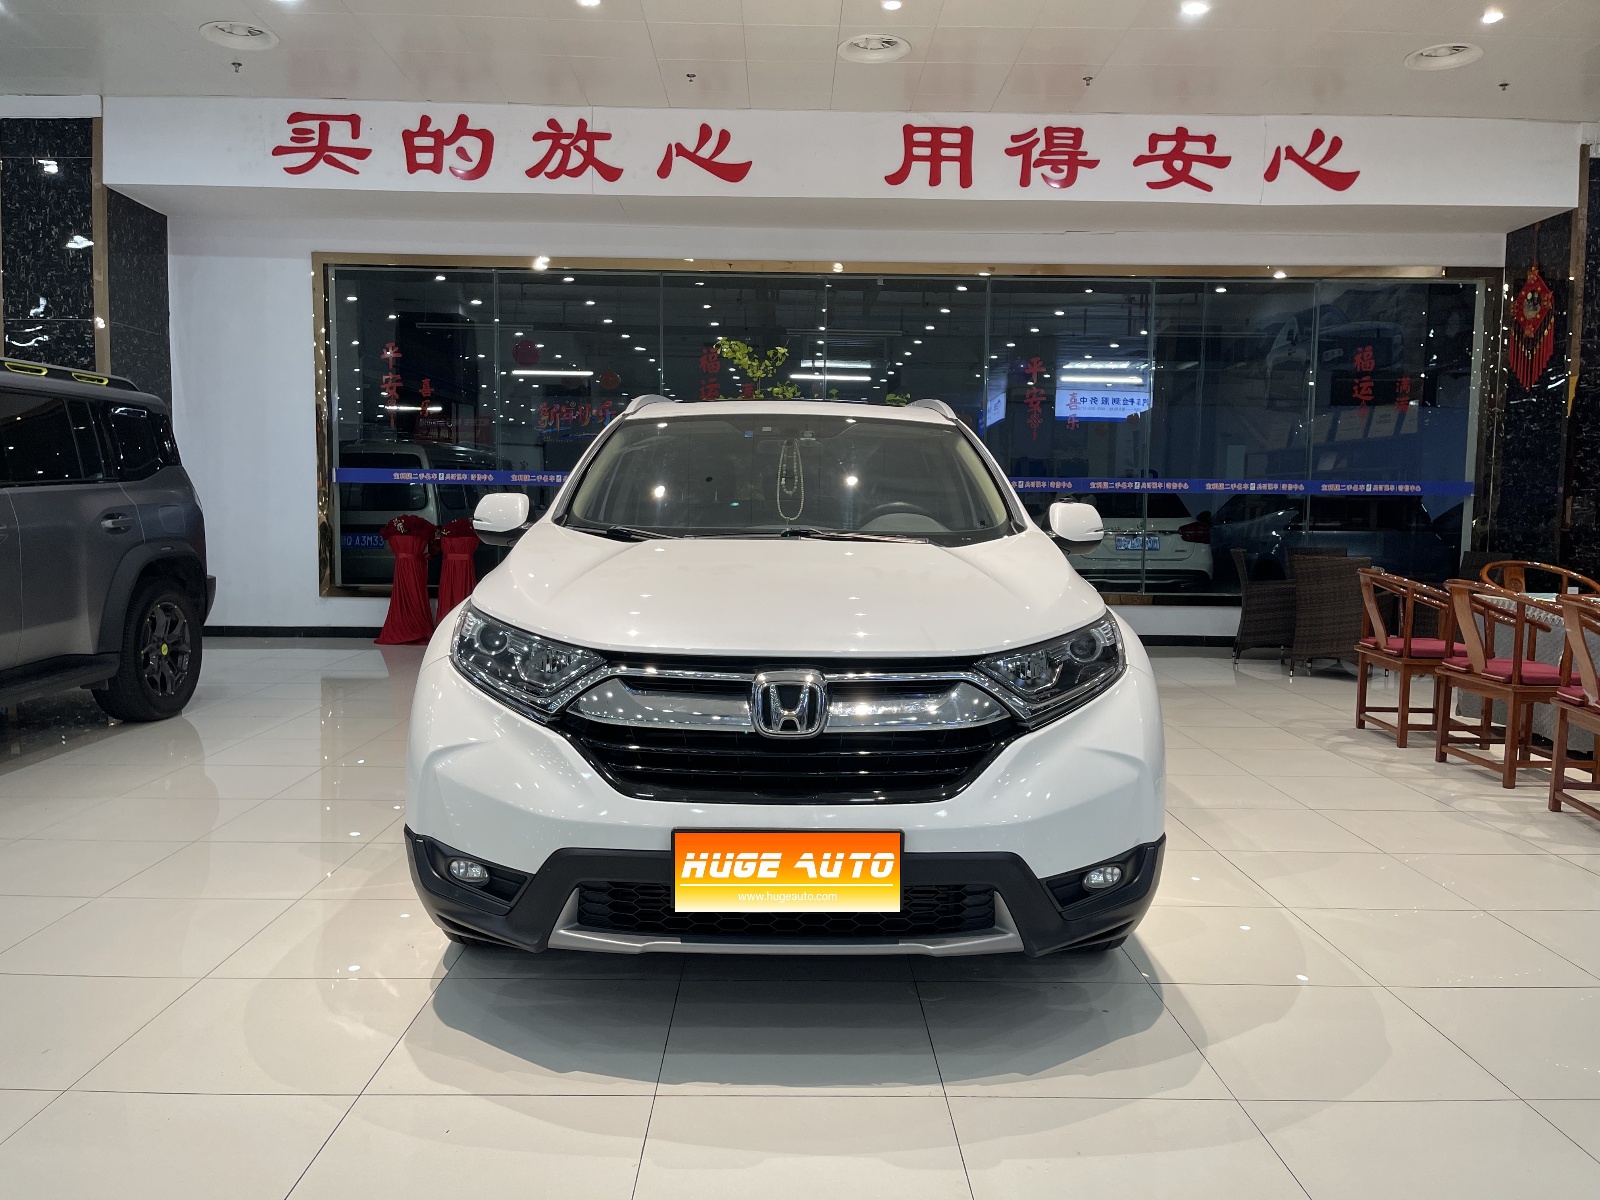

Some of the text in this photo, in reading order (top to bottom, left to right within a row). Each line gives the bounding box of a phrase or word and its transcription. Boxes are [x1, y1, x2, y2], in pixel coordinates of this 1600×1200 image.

[272, 111, 1361, 193] 买的放心 用得安心
[380, 342, 403, 399] 平安
[1024, 357, 1047, 413] 平安
[1352, 345, 1375, 401] 福运
